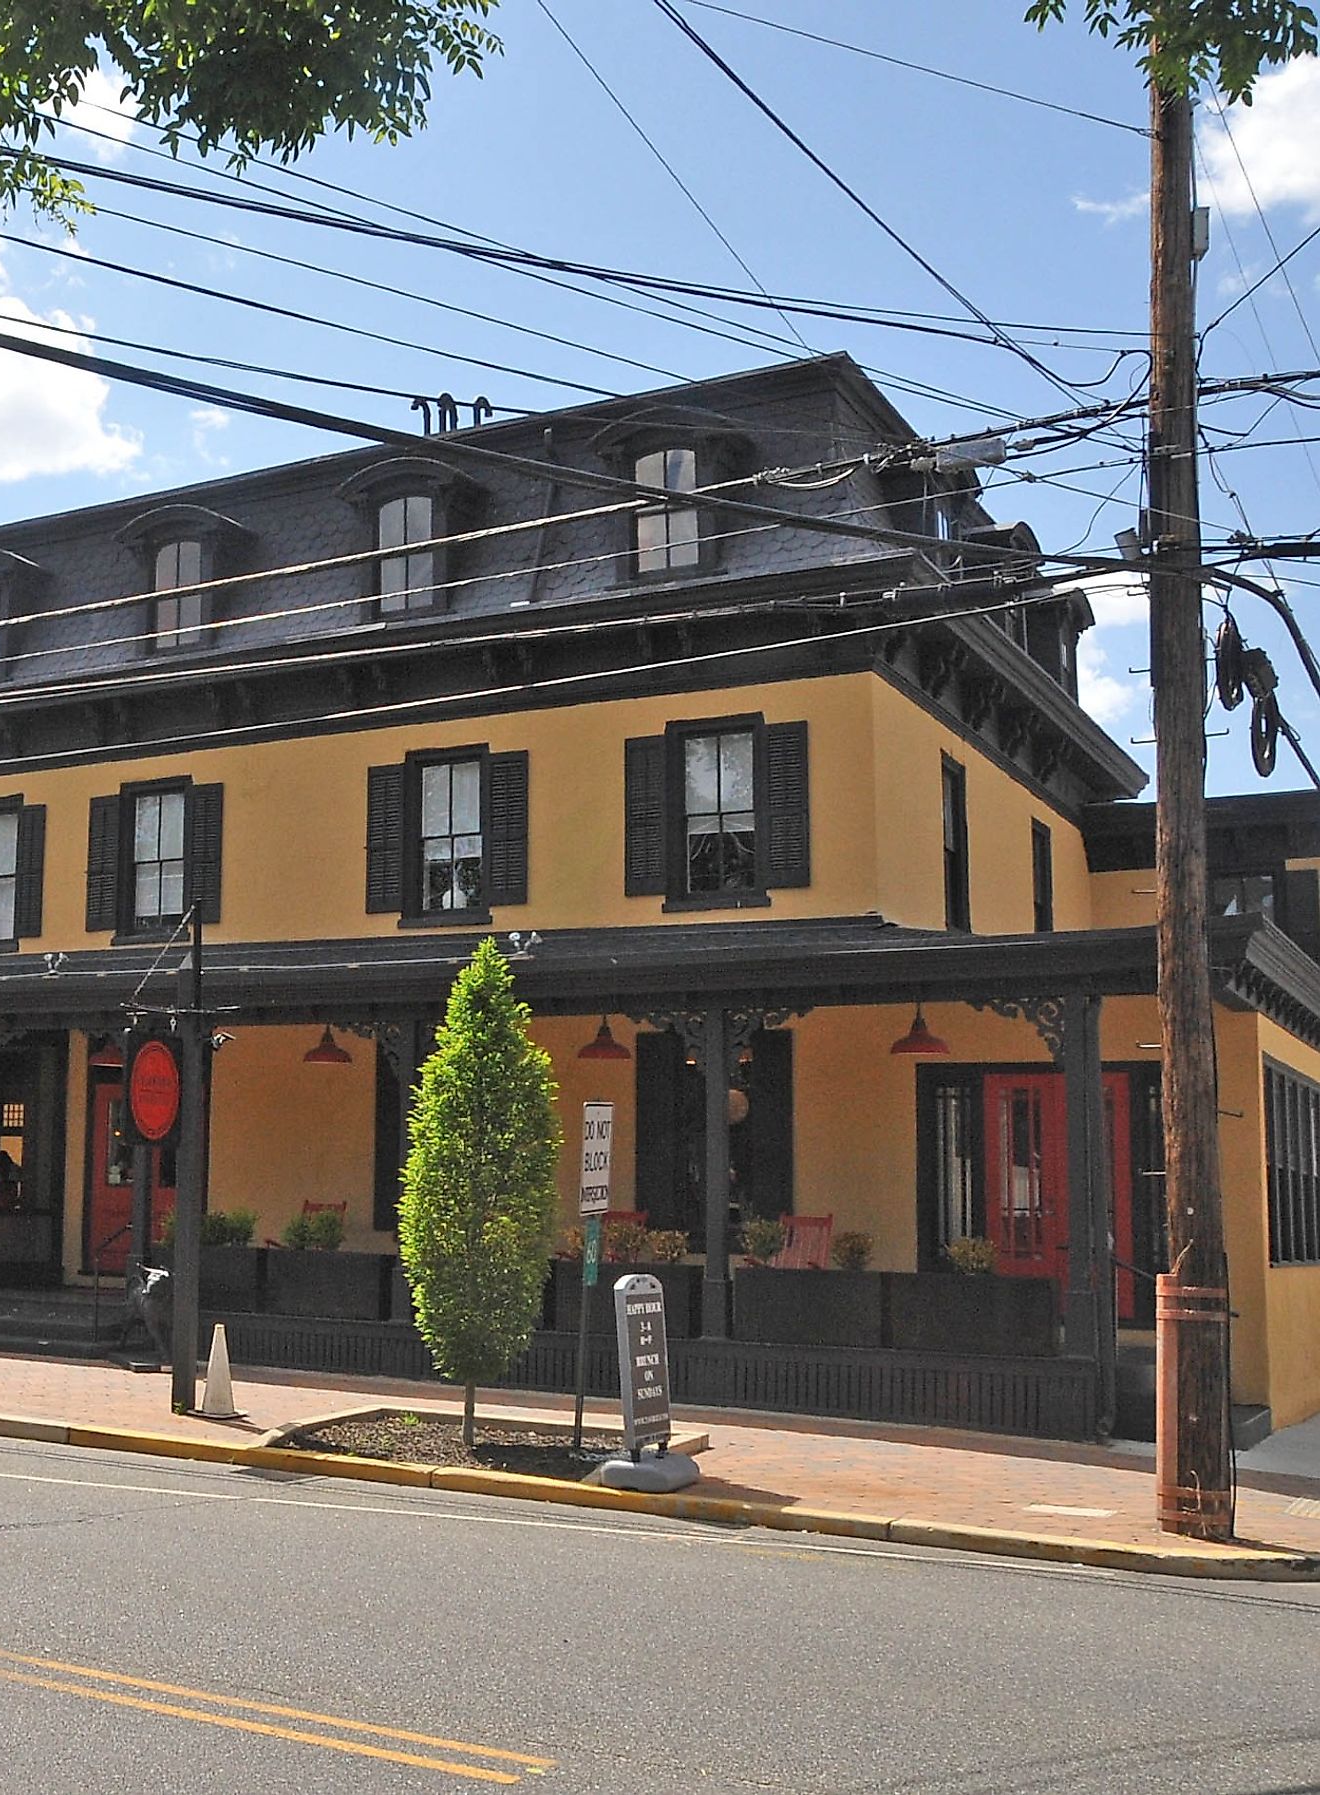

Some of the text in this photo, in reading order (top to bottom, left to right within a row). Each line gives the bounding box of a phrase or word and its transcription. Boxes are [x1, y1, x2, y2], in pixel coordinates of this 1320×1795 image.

[584, 1120, 612, 1140] DO NOT
[584, 1152, 610, 1172] BLOCK
[626, 1302, 662, 1316] HAPPY HOUR
[635, 1354, 660, 1368] BRUNCH
[644, 1370, 655, 1382] ON
[637, 1385, 663, 1401] SUNDAYS
